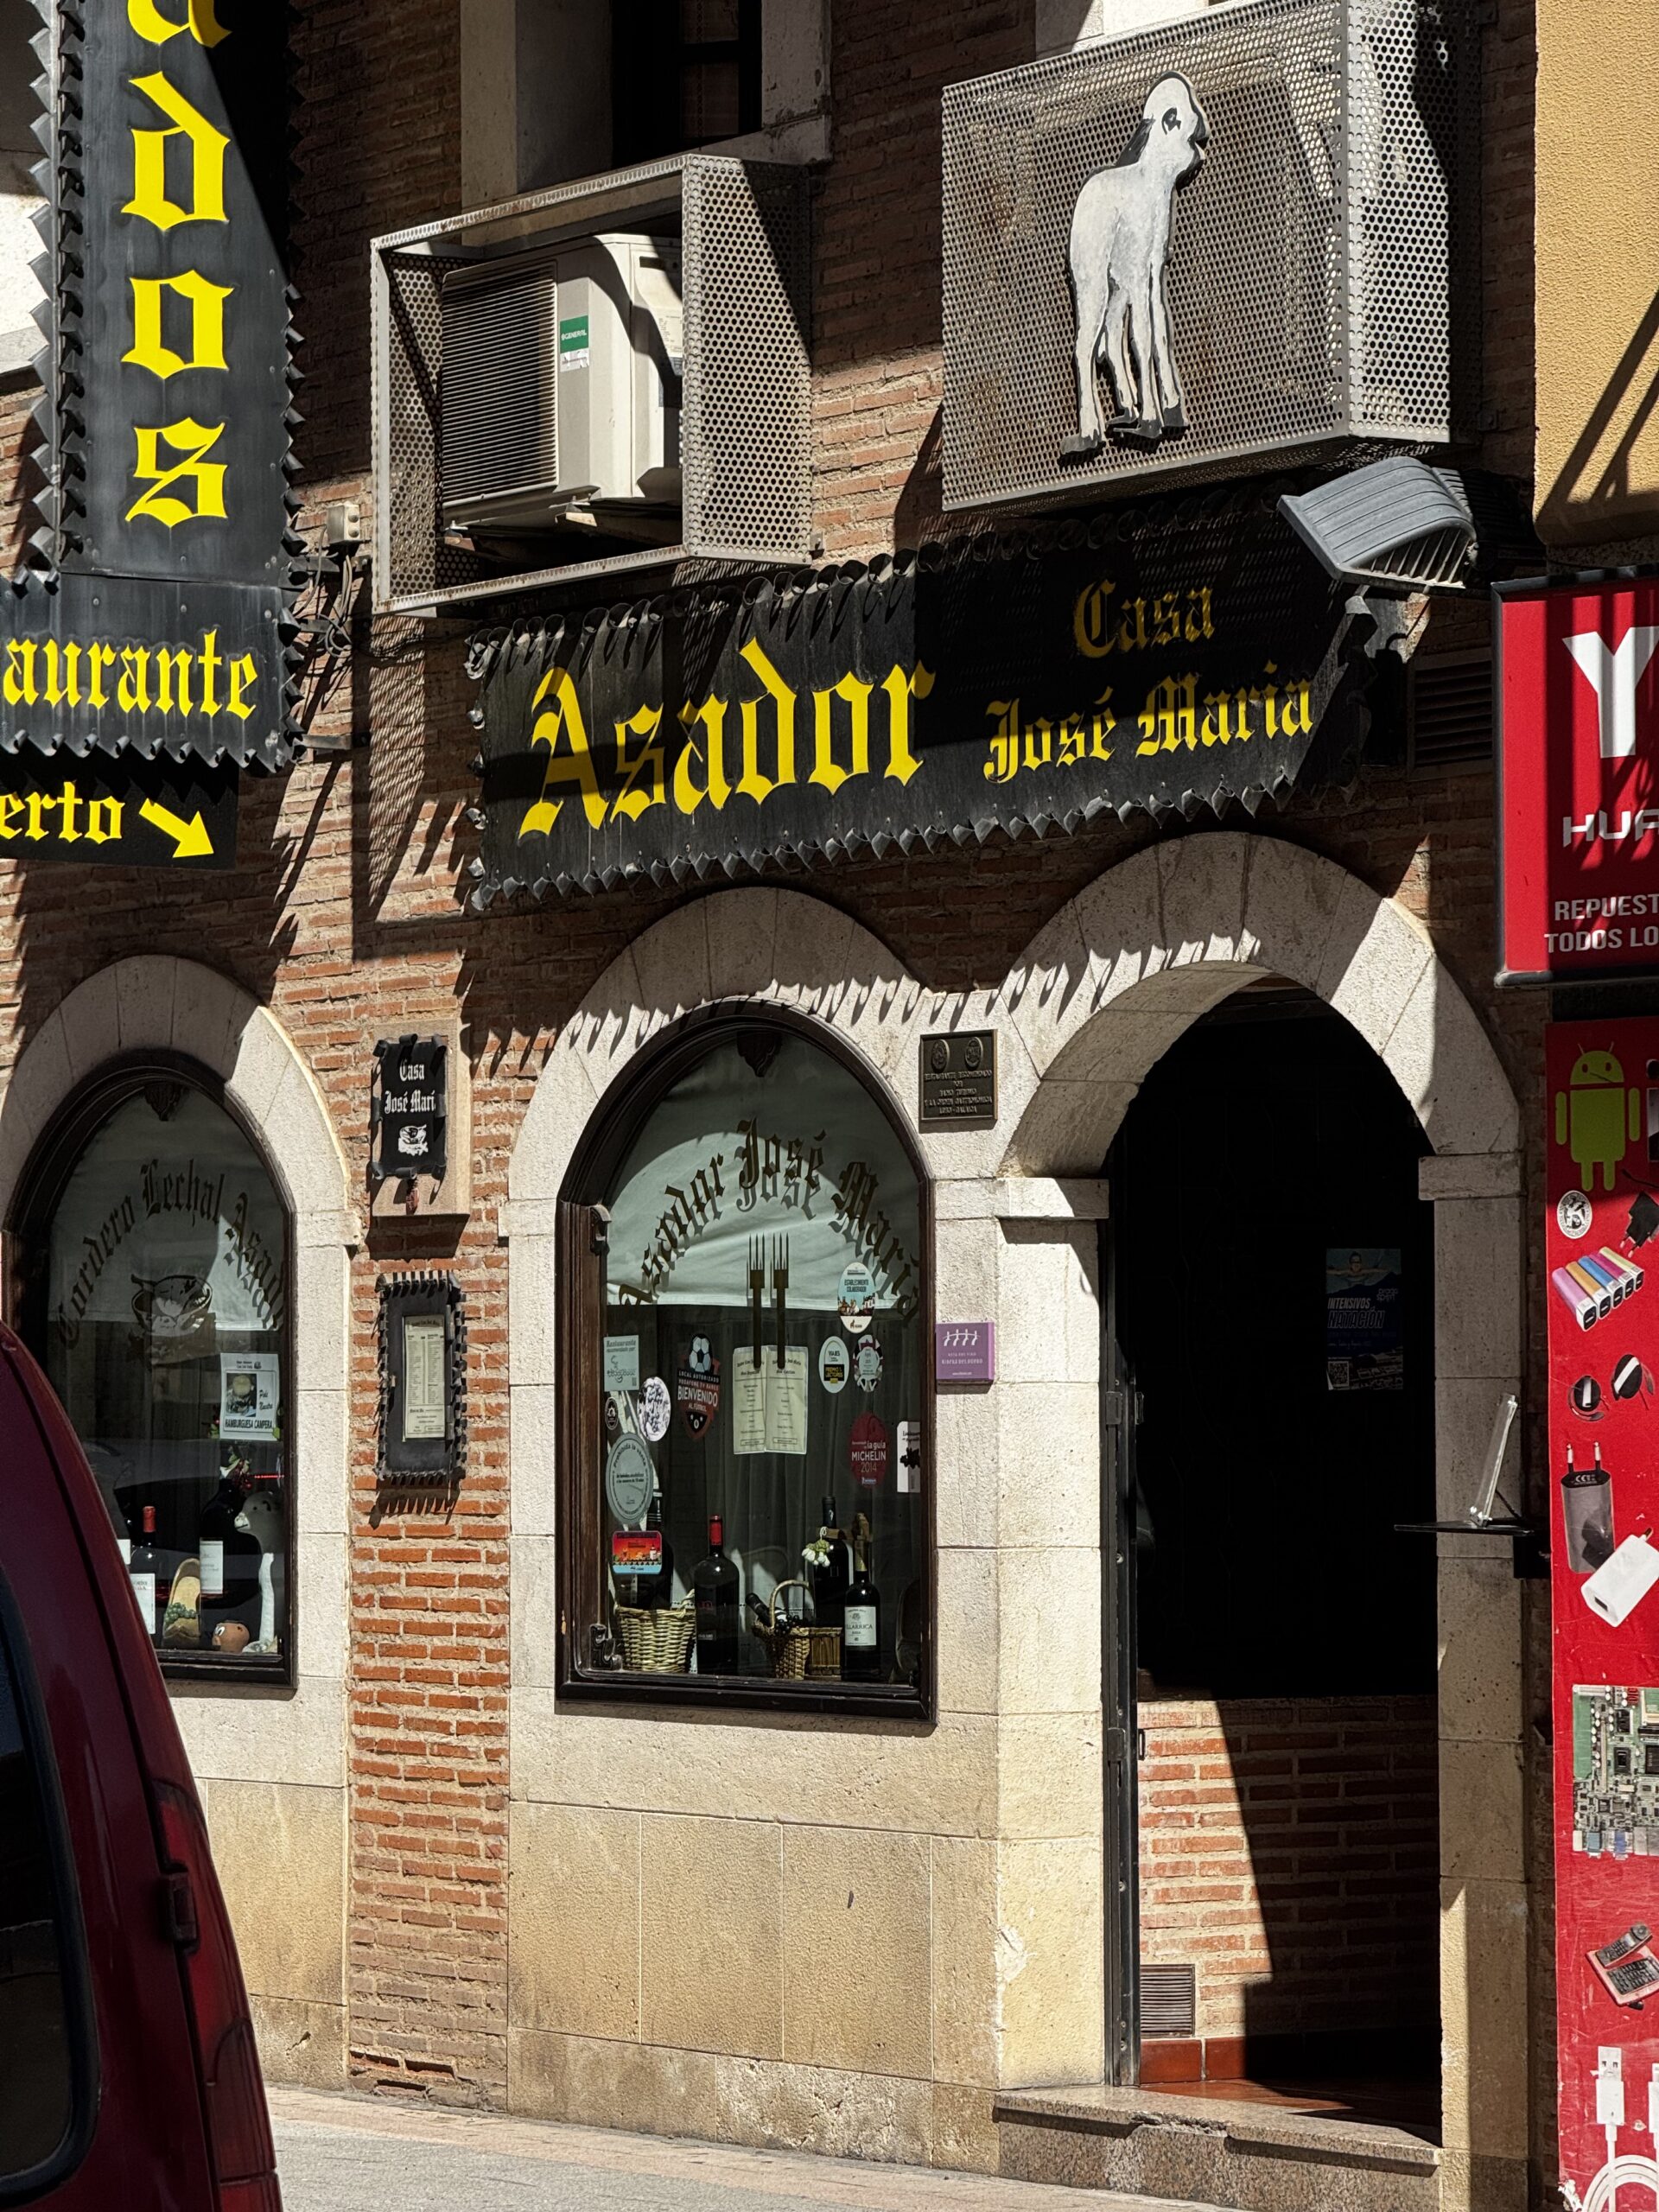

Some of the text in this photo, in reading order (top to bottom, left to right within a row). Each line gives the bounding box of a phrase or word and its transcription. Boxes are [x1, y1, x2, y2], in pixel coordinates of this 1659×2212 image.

[1073, 578, 1216, 658] Casa
[3, 628, 257, 720] aurante
[1562, 626, 1659, 759] Y
[518, 636, 937, 845] Asador
[983, 686, 1117, 784] José
[0, 780, 125, 844] erto
[1554, 893, 1659, 921] REPUEST
[1544, 925, 1659, 953] TODOS LO
[399, 1058, 425, 1082] Casa
[385, 1089, 436, 1115] José Marí
[737, 1115, 828, 1190] José
[1326, 1306, 1385, 1329] NATACIÓN
[1327, 1297, 1371, 1310] INTENSIVOS
[677, 1385, 719, 1408] BIENVENIDO
[851, 1451, 887, 1461] MICHELIN
[861, 1461, 877, 1473] 2014
